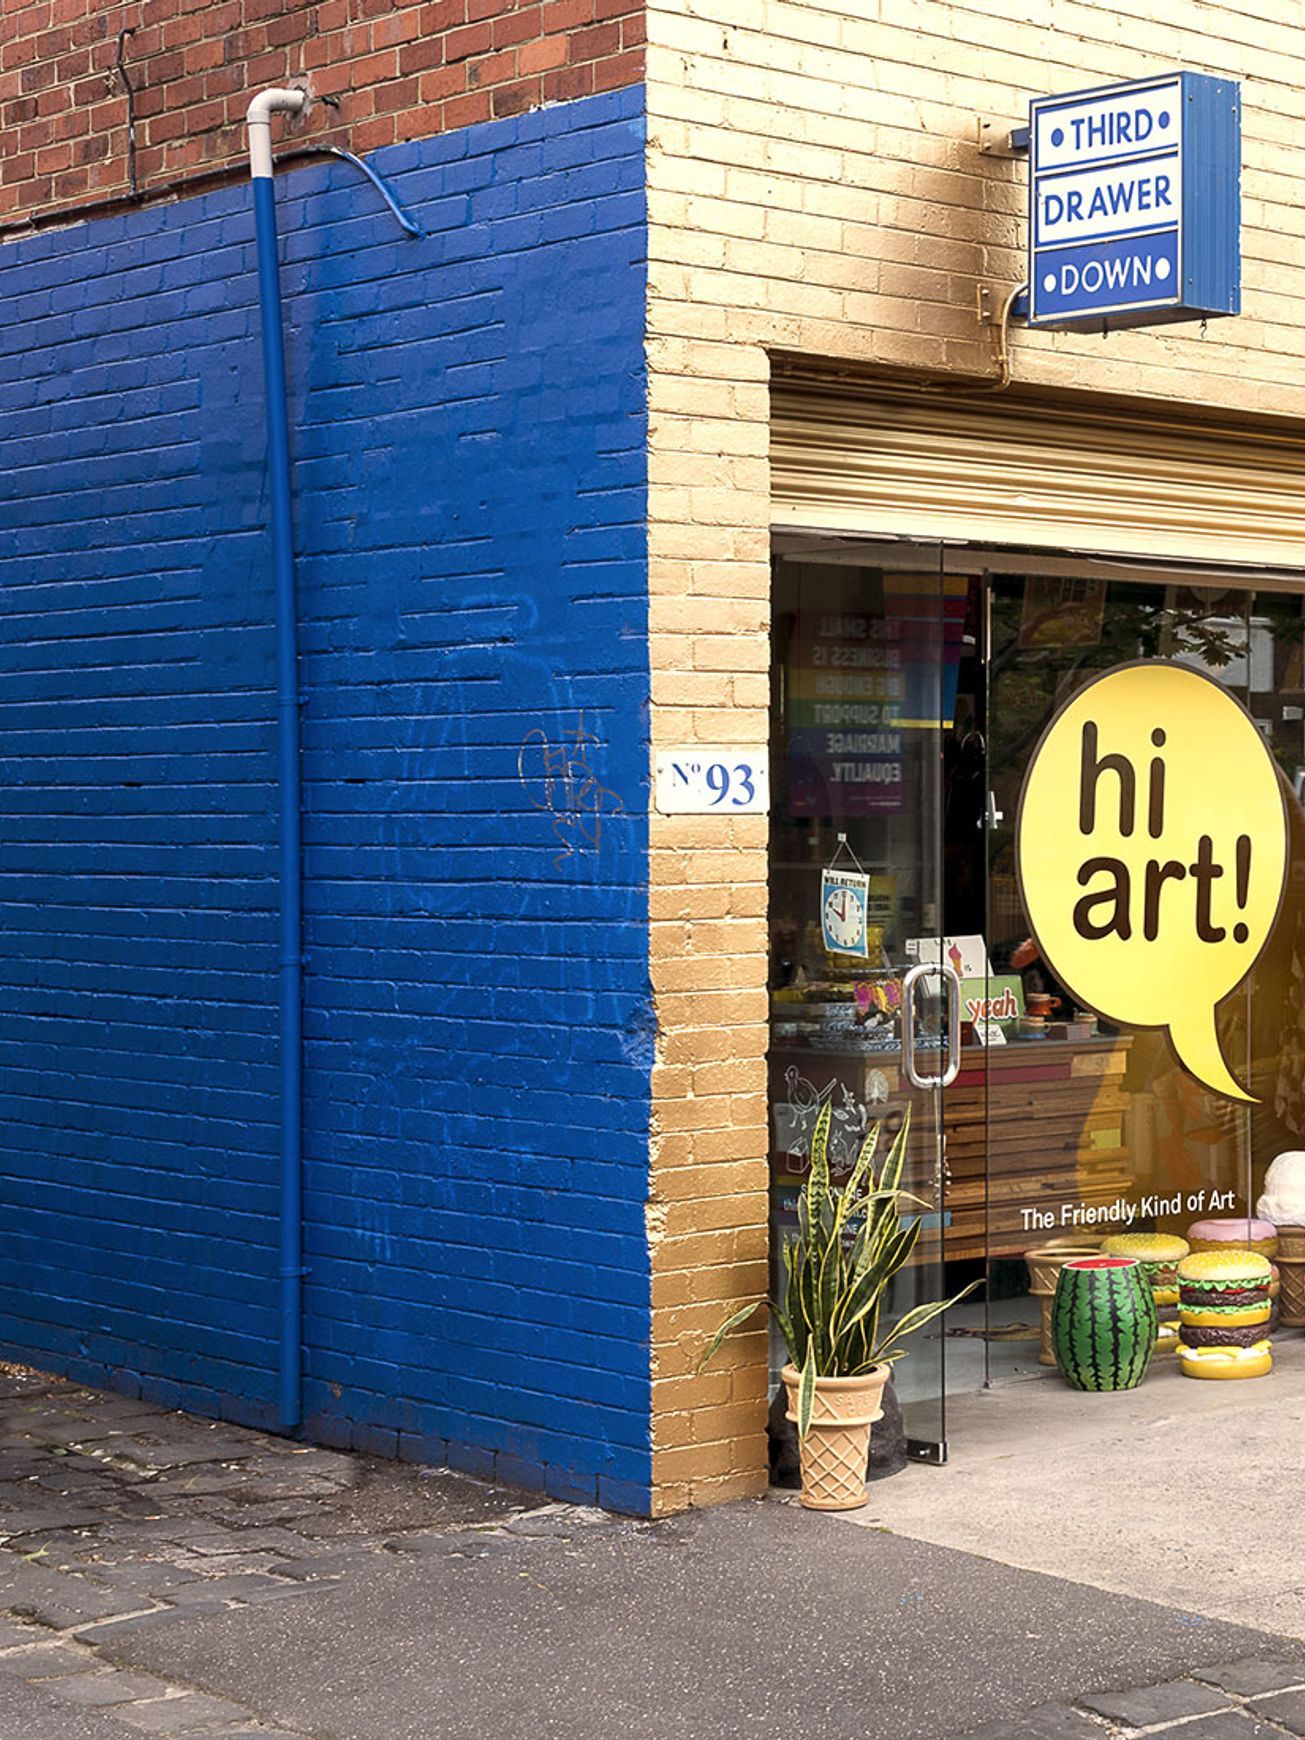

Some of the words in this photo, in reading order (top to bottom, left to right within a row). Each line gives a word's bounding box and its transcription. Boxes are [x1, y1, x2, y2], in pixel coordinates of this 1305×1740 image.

[1070, 108, 1153, 150] THIRD
[1044, 175, 1172, 226] DRAWER
[1061, 256, 1152, 296] DOWN
[706, 763, 755, 806] 93
[1079, 720, 1167, 839] hi
[1073, 834, 1252, 944] art!
[966, 987, 1018, 1026] yeah
[1020, 1208, 1055, 1231] The
[1061, 1199, 1137, 1226] Friendly
[1141, 1192, 1182, 1218] Kind
[1187, 1192, 1205, 1212] of
[1208, 1190, 1236, 1212] Art
